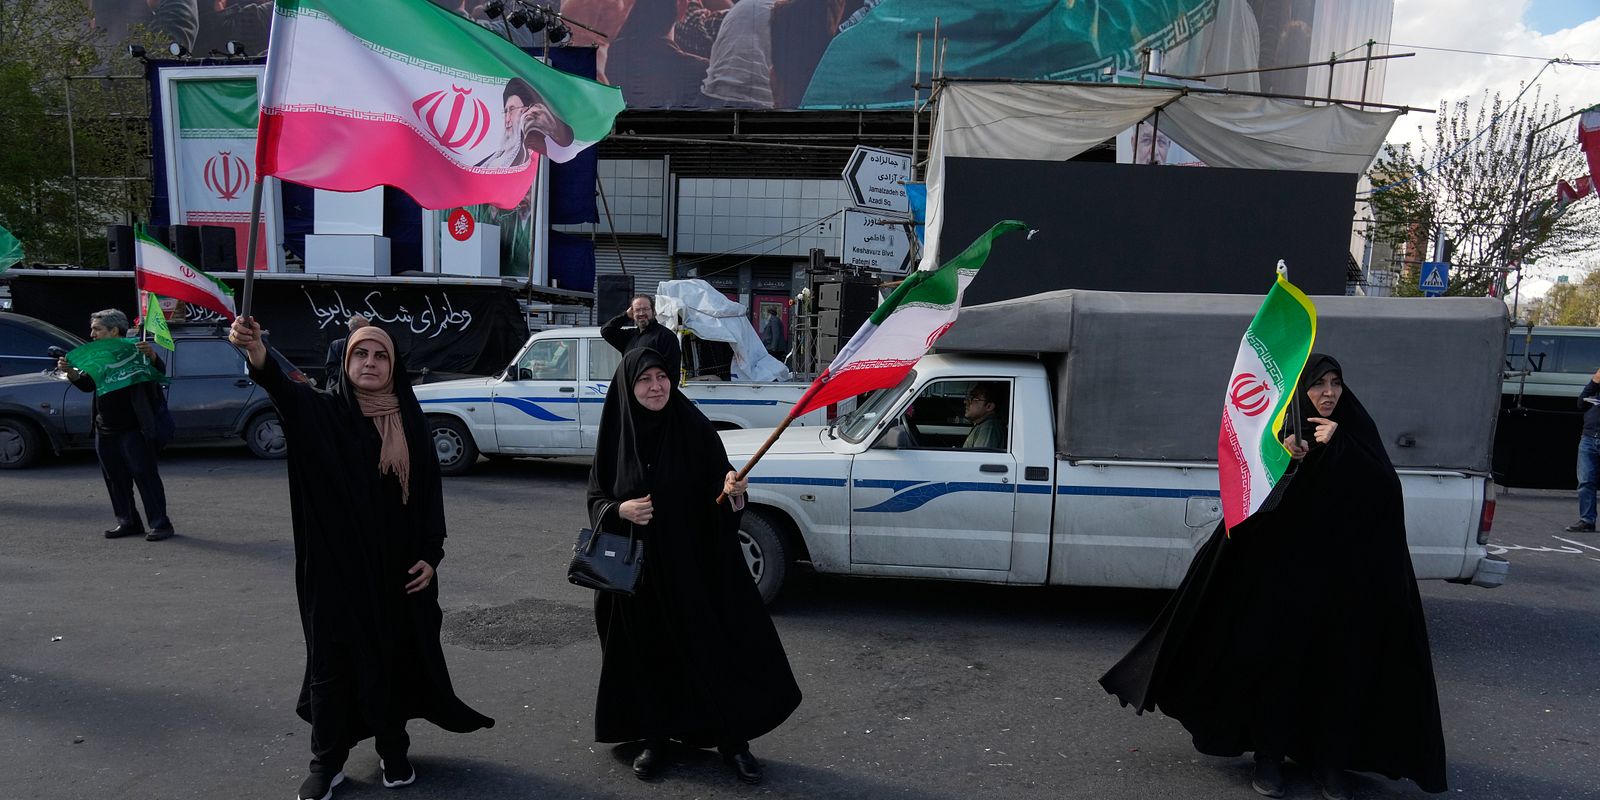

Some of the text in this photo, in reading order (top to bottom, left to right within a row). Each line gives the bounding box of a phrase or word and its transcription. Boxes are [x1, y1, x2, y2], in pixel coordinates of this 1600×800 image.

[870, 156, 898, 168] جمالزاده
[877, 173, 898, 184] آزادی
[868, 185, 899, 196] Jamalzadeh
[868, 196, 883, 205] Azadi
[863, 233, 886, 243] فاطمی
[851, 257, 871, 265] Fatemi
[411, 294, 436, 334] ای
[427, 291, 473, 339] وطنم
